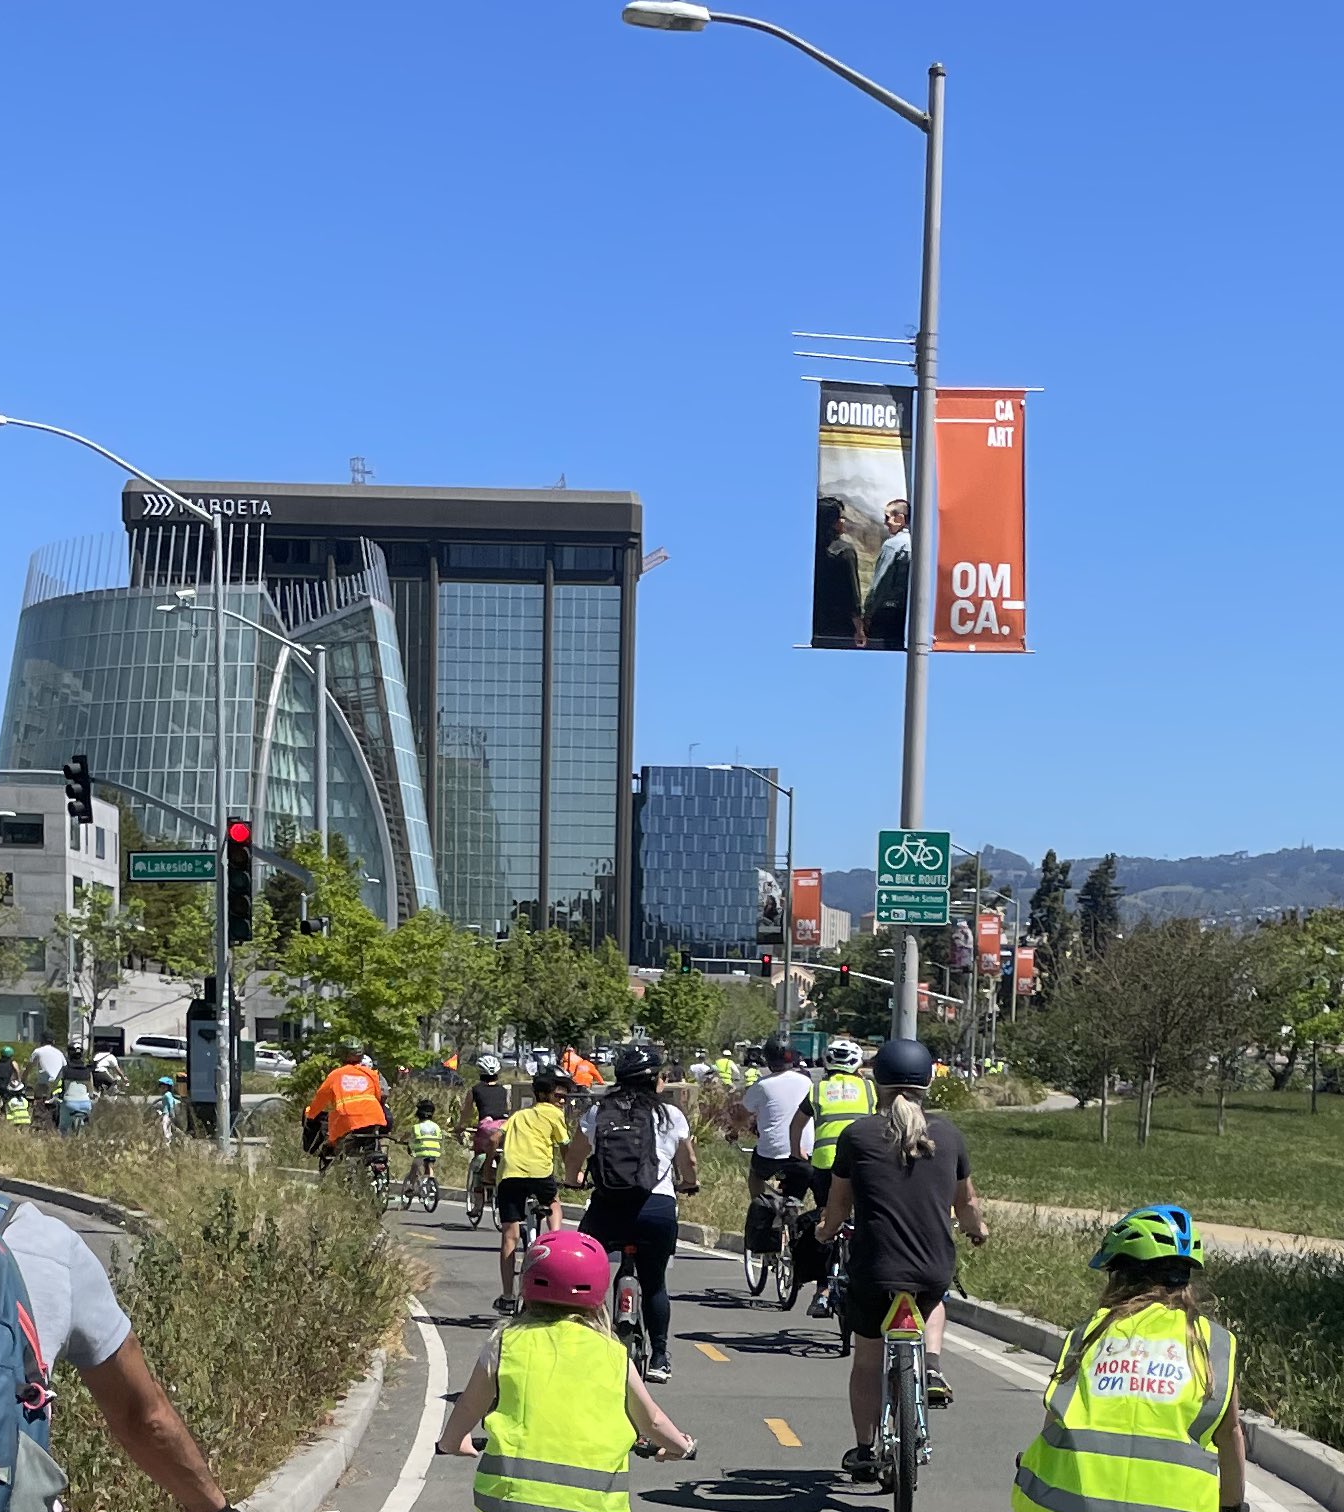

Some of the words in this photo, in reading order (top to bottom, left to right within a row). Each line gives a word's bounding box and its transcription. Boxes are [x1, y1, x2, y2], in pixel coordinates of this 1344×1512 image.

[994, 399, 1014, 422] CA
[987, 426, 1014, 448] ART
[952, 561, 1011, 598] OM
[950, 599, 1010, 636] CA.
[147, 859, 194, 873] Lakeside
[895, 874, 916, 885] BIKE
[918, 875, 947, 886] ROUTE
[1093, 1359, 1141, 1376] MORE
[1146, 1360, 1185, 1381] KIDS
[1128, 1376, 1176, 1395] BIKES
